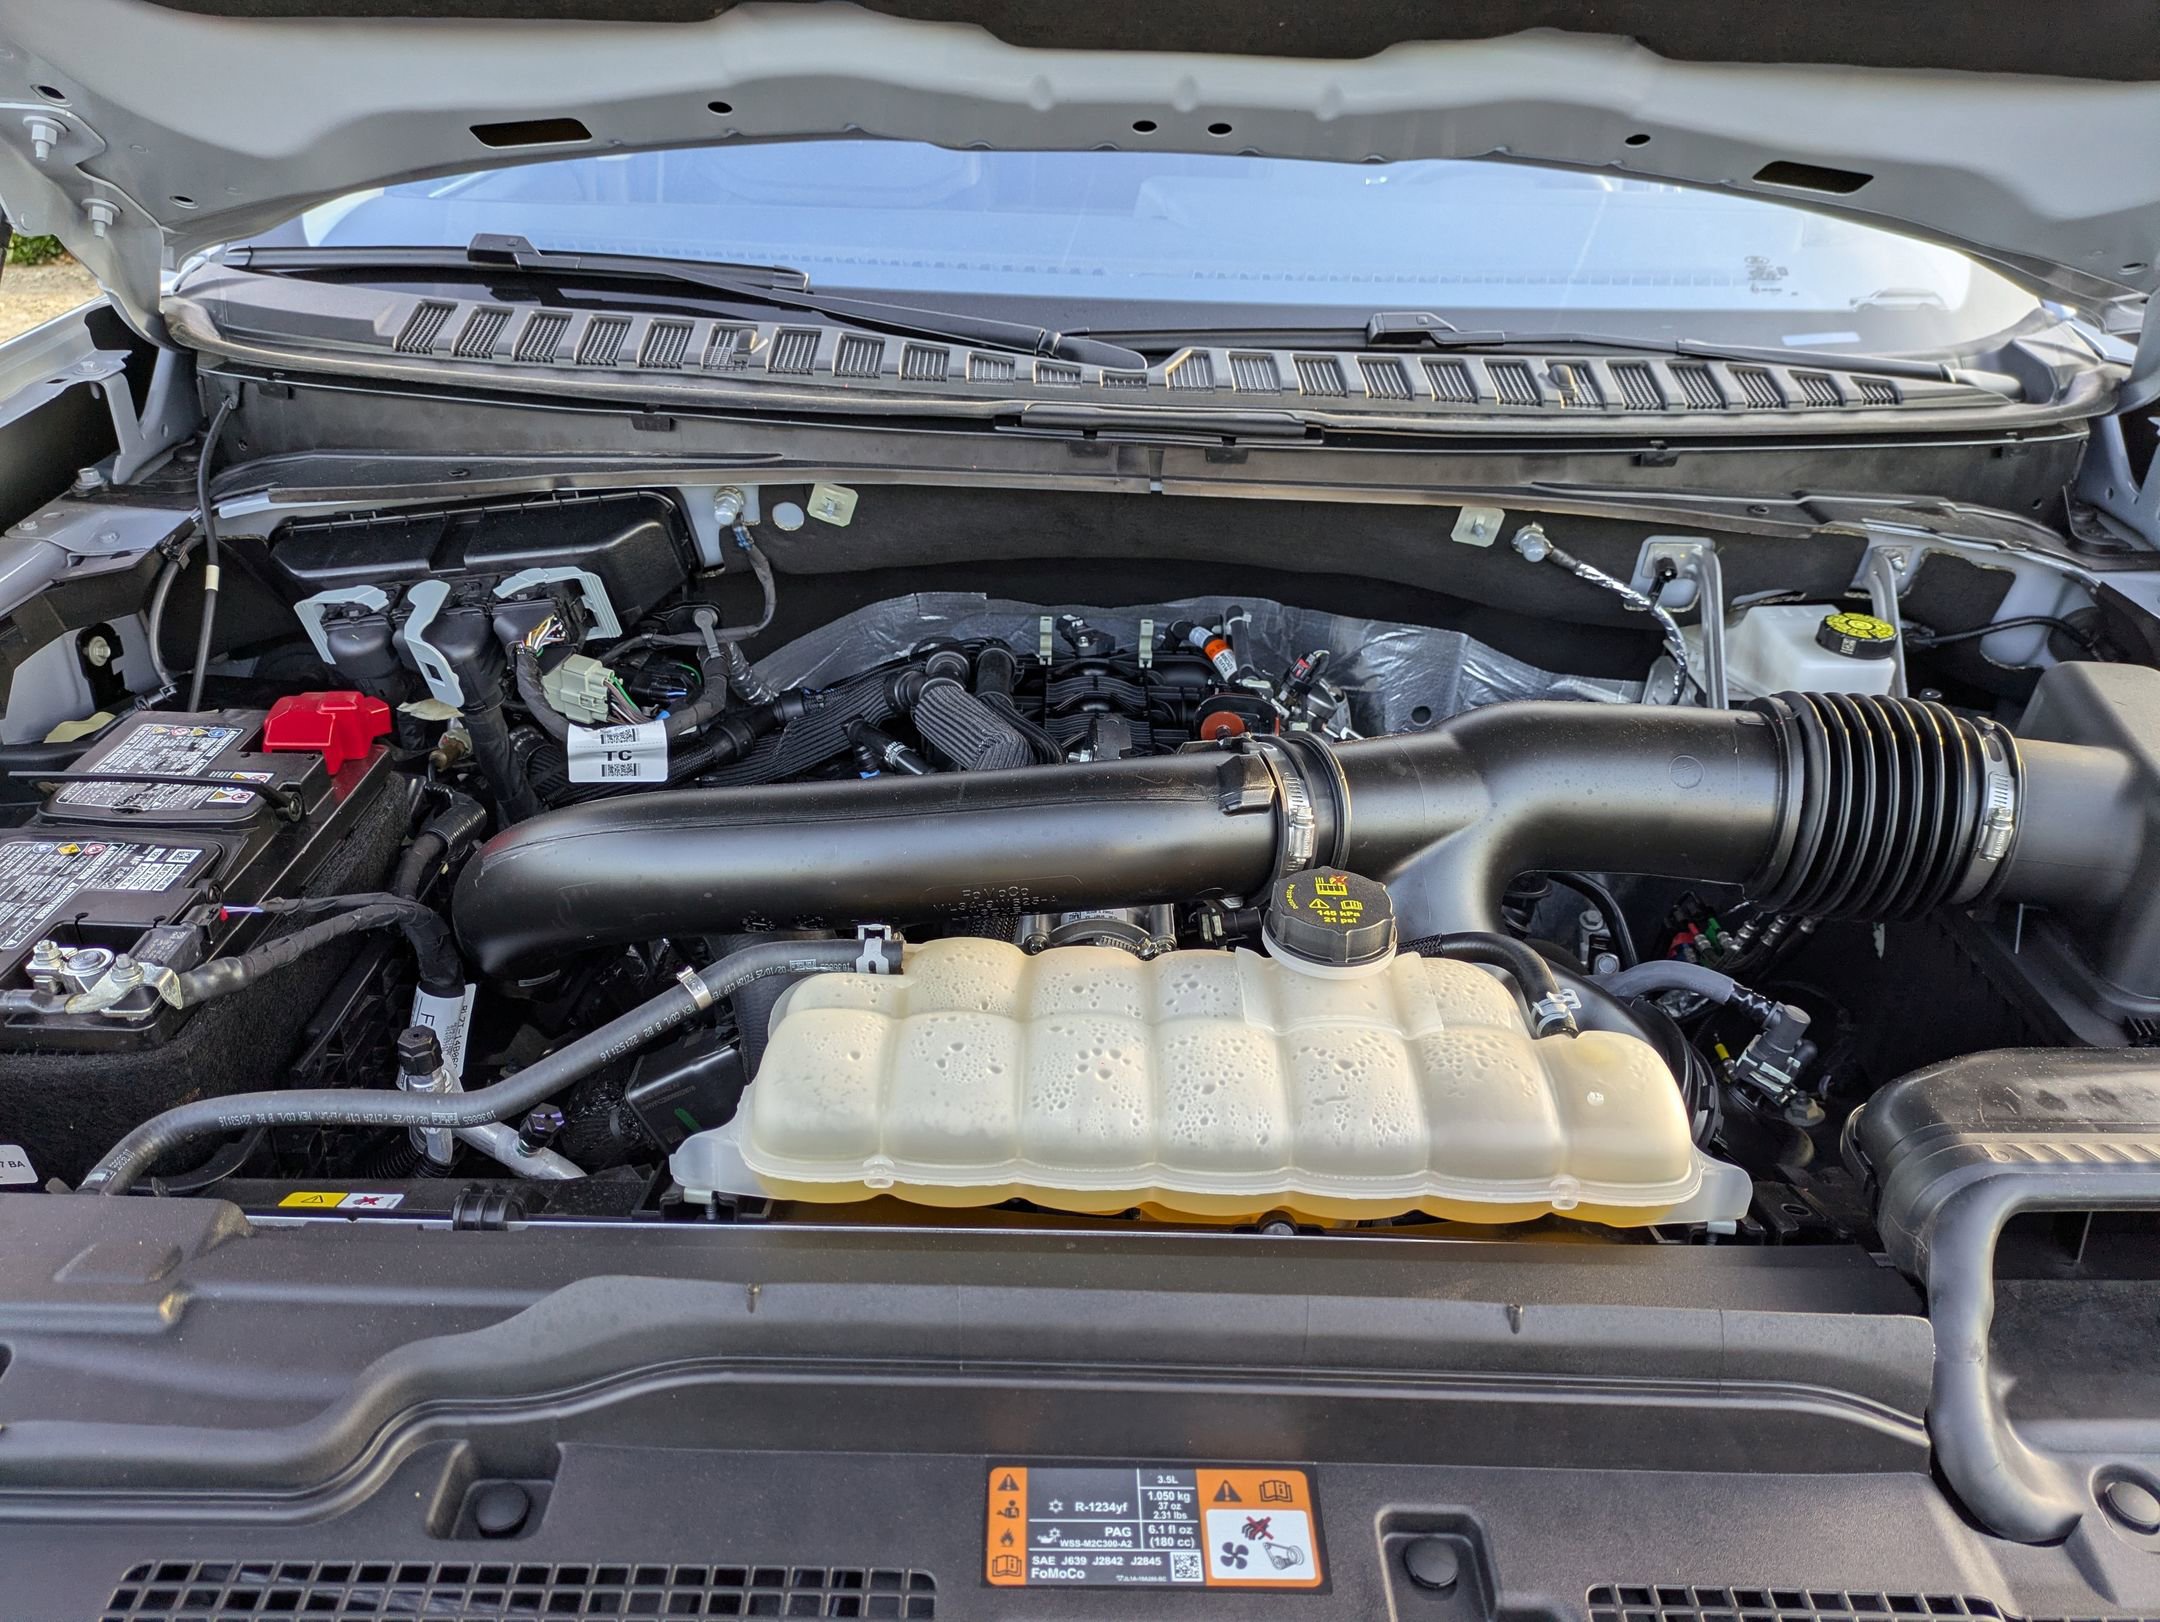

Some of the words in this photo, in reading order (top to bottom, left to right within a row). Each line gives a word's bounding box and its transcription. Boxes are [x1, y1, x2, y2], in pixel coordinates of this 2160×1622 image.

[602, 749, 633, 762] TC
[8, 1160, 26, 1168] BA
[1157, 1475, 1179, 1484] 3.5L
[1147, 1491, 1175, 1501] 1.050
[1177, 1491, 1191, 1503] kg
[1075, 1502, 1128, 1514] R-1234yf
[1158, 1502, 1168, 1510] 37
[1153, 1511, 1171, 1519] 2.31
[1173, 1511, 1188, 1520] lbs
[1104, 1527, 1132, 1537] PAG
[1148, 1525, 1165, 1534] 6.1
[1167, 1525, 1176, 1534] fl
[1178, 1526, 1193, 1535] oz
[1149, 1537, 1174, 1549] (180
[1177, 1537, 1196, 1549] cc)
[1032, 1556, 1056, 1566] SAE
[1061, 1556, 1087, 1566] J639
[1092, 1557, 1124, 1566] J2842
[1130, 1557, 1162, 1566] J2845
[1031, 1568, 1086, 1580] FoMoCo
